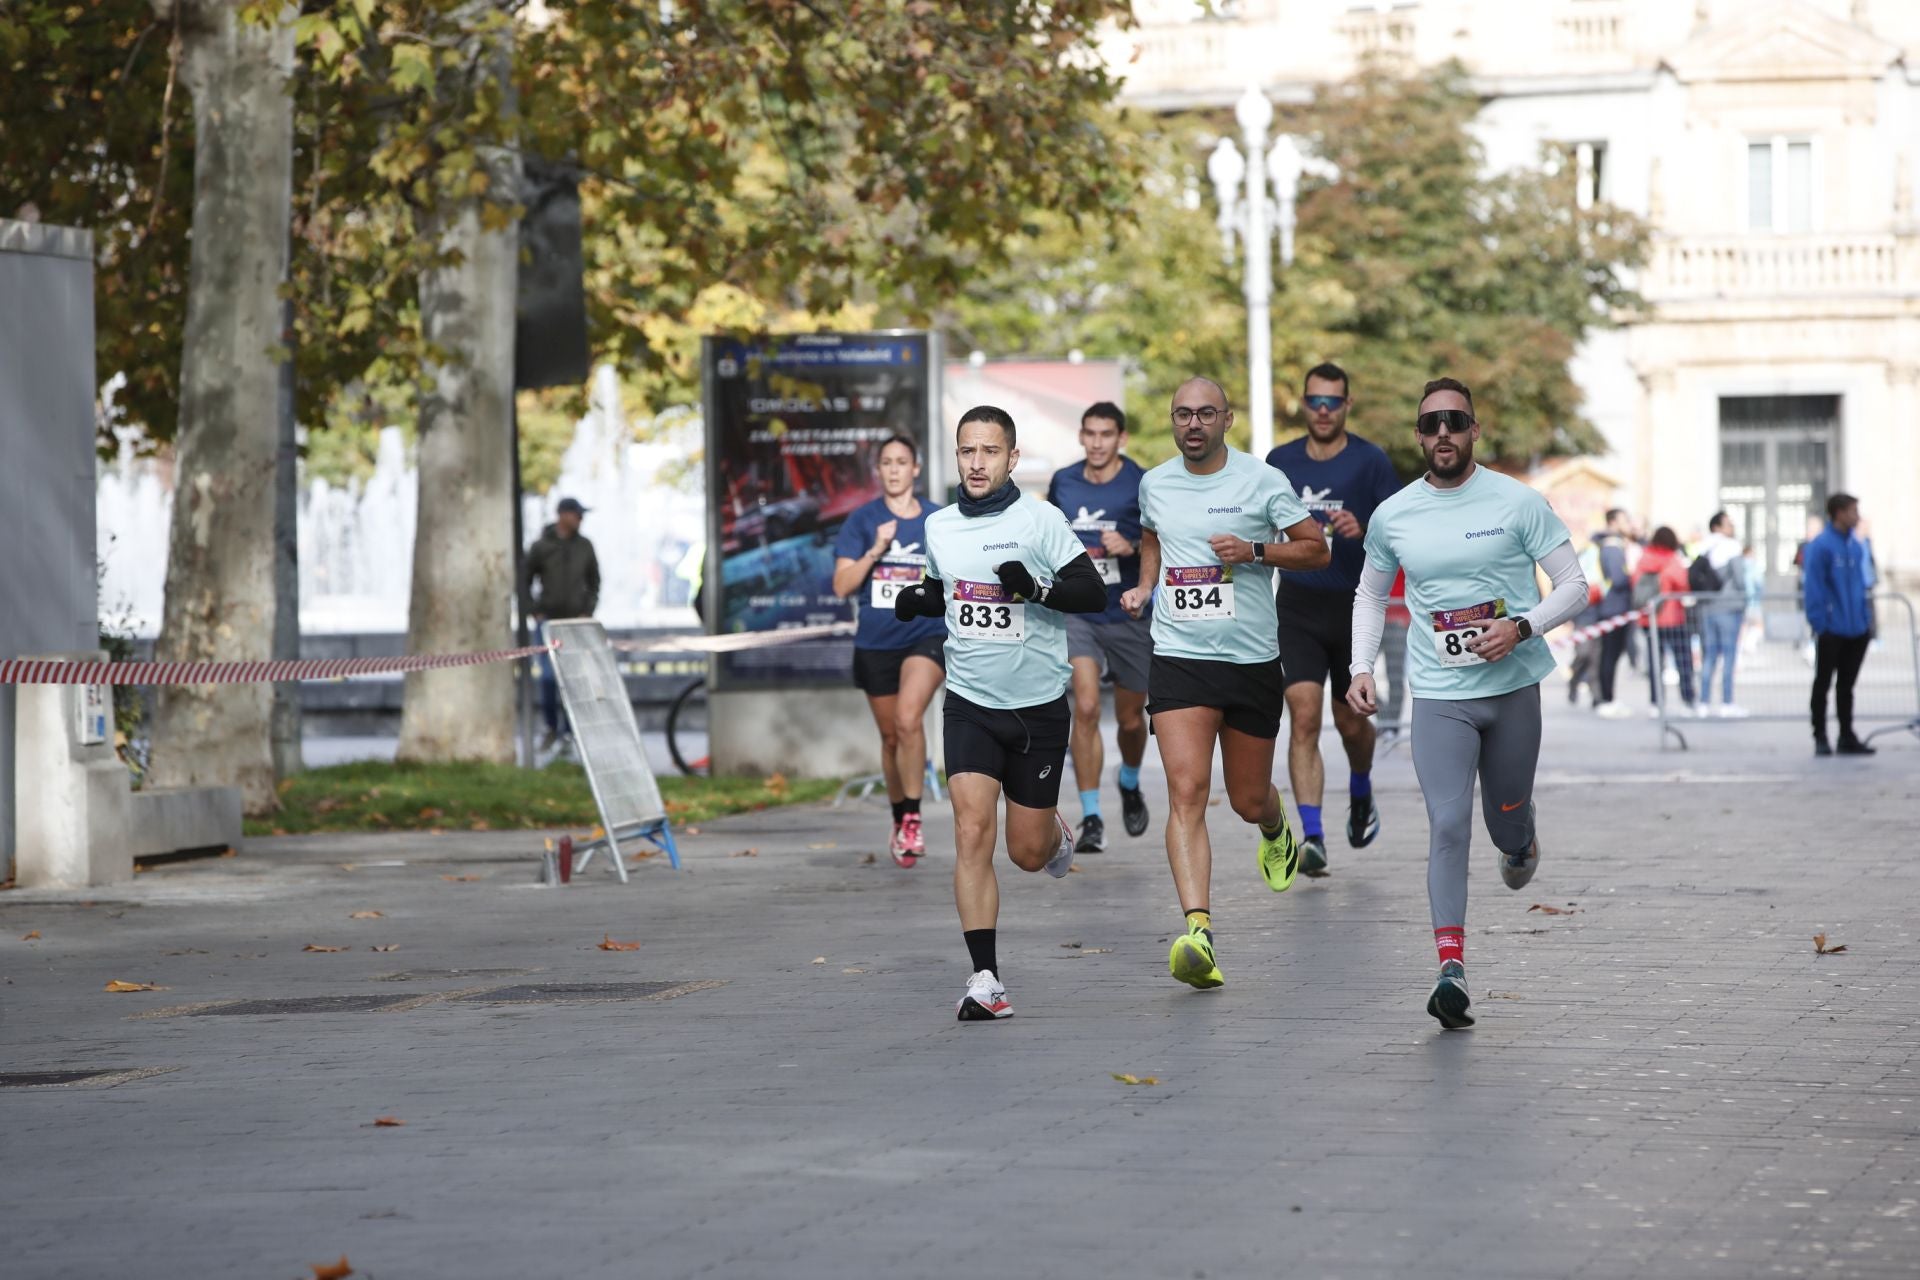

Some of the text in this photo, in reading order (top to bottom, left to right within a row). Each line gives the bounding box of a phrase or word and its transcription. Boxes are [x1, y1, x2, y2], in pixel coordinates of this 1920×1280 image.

[1207, 506, 1243, 515] OneHealth
[1465, 526, 1505, 540] OneHealth
[982, 541, 1019, 552] OneHealth
[1174, 587, 1223, 610] 834
[959, 603, 1012, 630] 833
